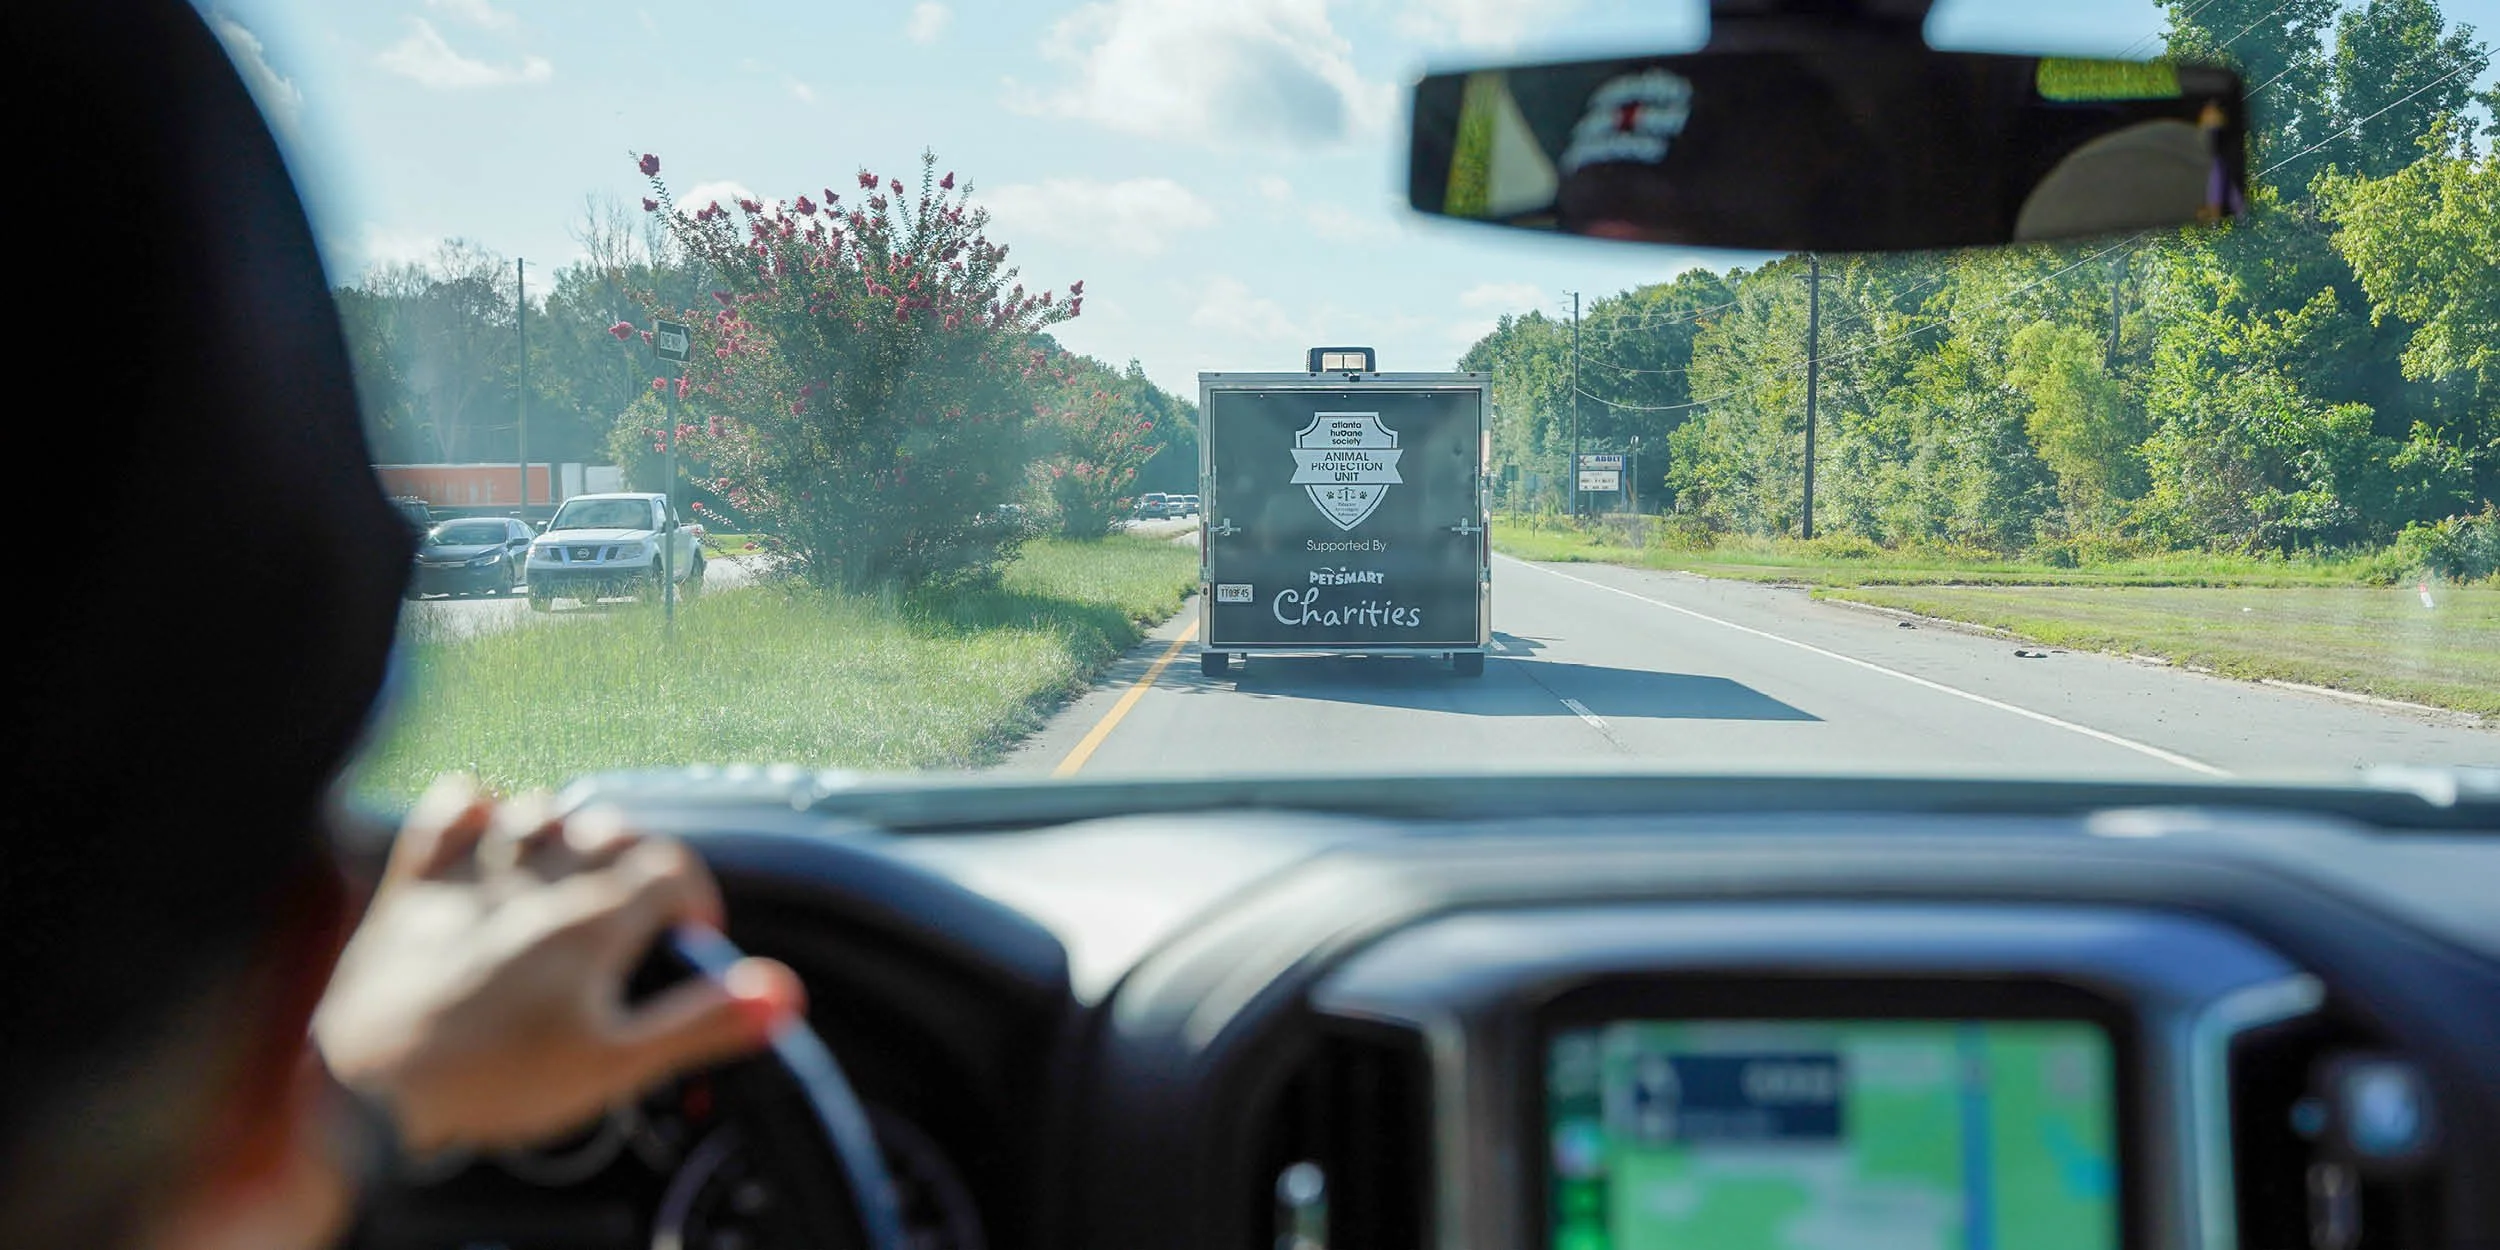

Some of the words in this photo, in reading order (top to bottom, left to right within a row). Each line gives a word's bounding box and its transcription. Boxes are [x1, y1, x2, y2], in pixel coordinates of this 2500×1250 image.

[1331, 421, 1361, 429] atlanta
[1332, 437, 1361, 446] society
[1325, 452, 1369, 461] ANIMAL
[1311, 462, 1383, 471] PROTECTION
[1335, 472, 1359, 481] UNIT
[1306, 540, 1369, 552] Supported
[1373, 540, 1387, 552] By
[1309, 568, 1384, 585] PETSMART
[1273, 587, 1421, 627] Charities
